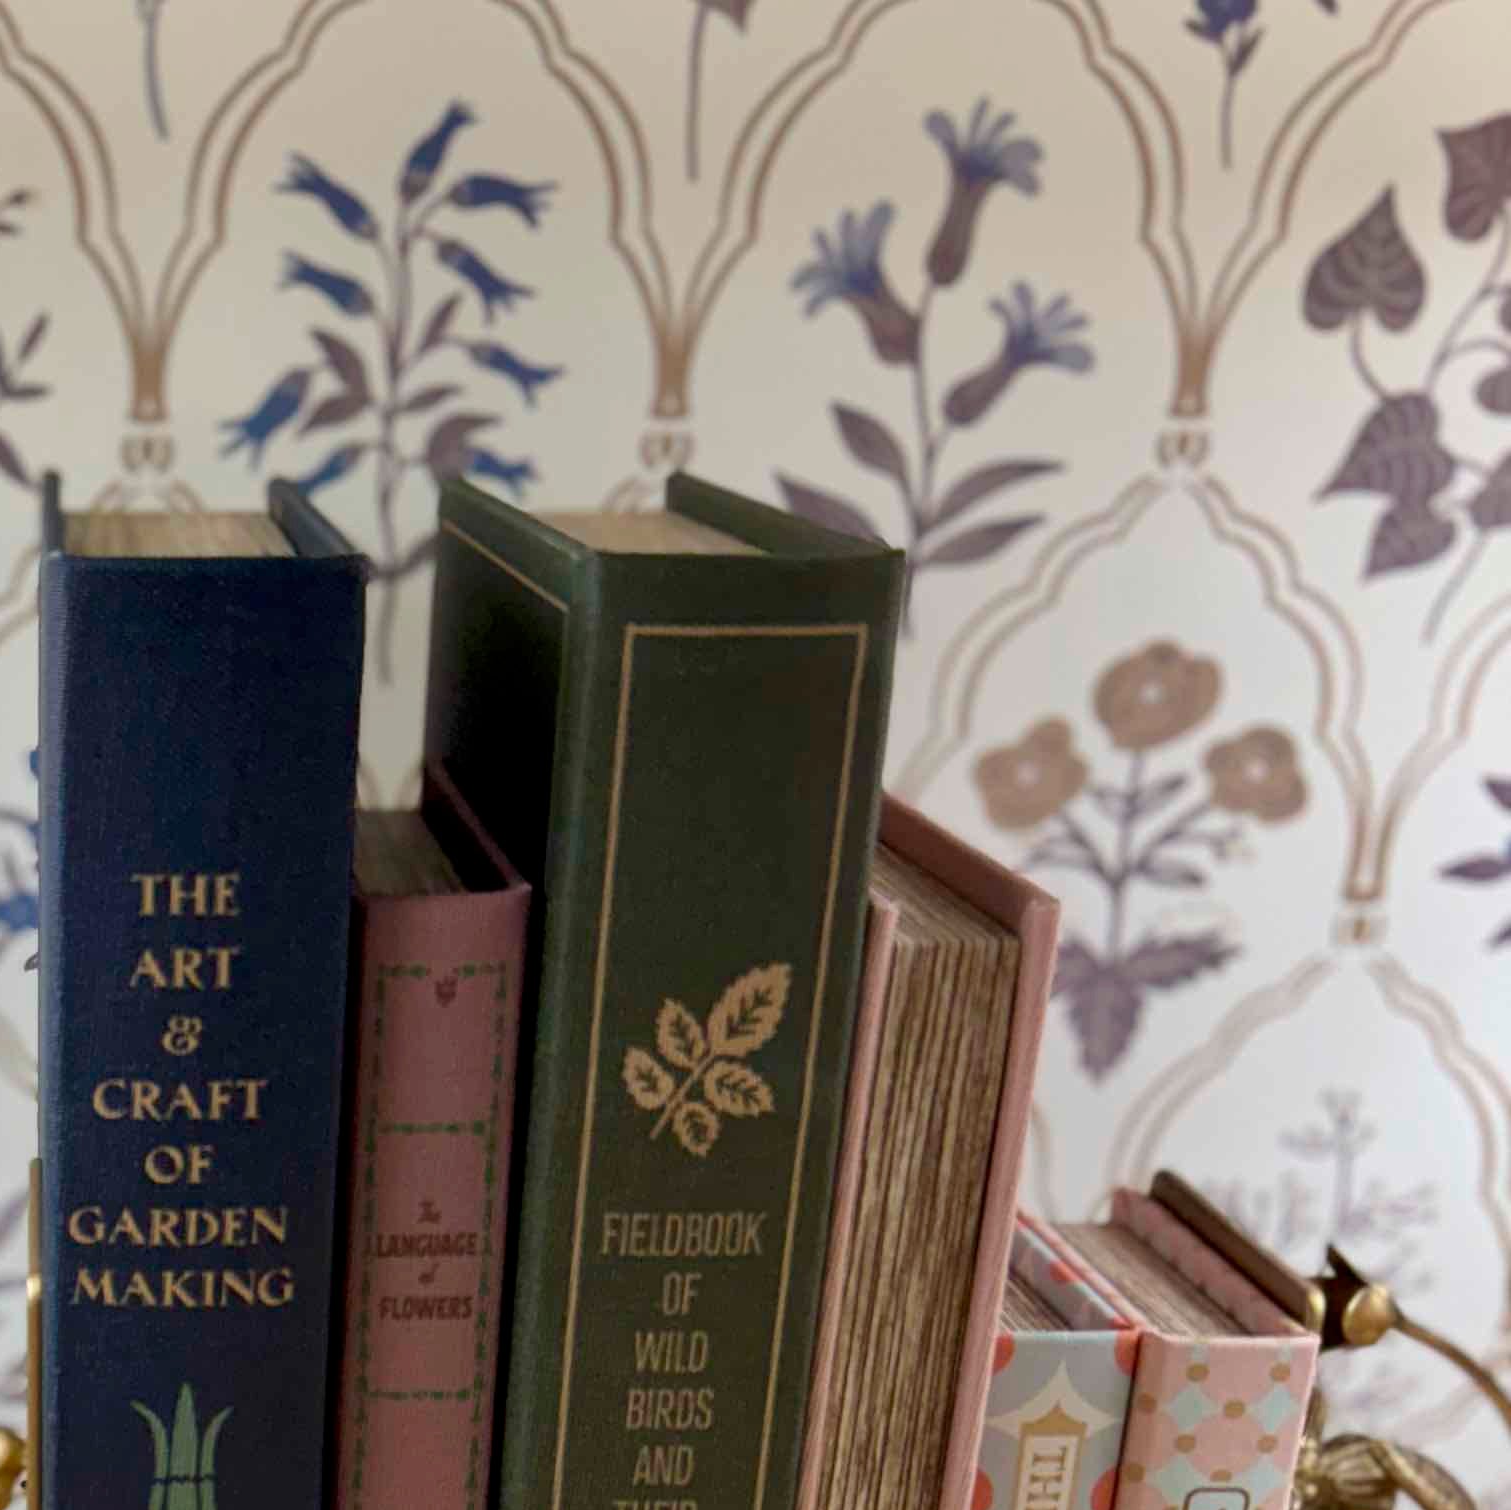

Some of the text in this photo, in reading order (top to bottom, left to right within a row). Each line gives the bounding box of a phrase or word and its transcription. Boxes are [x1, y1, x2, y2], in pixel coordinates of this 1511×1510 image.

[131, 873, 241, 917] THE
[130, 947, 240, 990] ART
[161, 1015, 202, 1056] &
[93, 1079, 267, 1120] CRAFT
[145, 1144, 213, 1185] OF
[68, 1206, 288, 1247] GARDEN
[376, 1232, 478, 1258] LANGUAGE
[601, 1211, 767, 1257] FIELDBOOK
[71, 1265, 294, 1308] MAKING
[662, 1272, 701, 1316] OF
[379, 1296, 473, 1320] FLOWERS
[634, 1330, 709, 1374] WILD
[625, 1388, 714, 1431] BIRDS
[633, 1445, 693, 1487] AND
